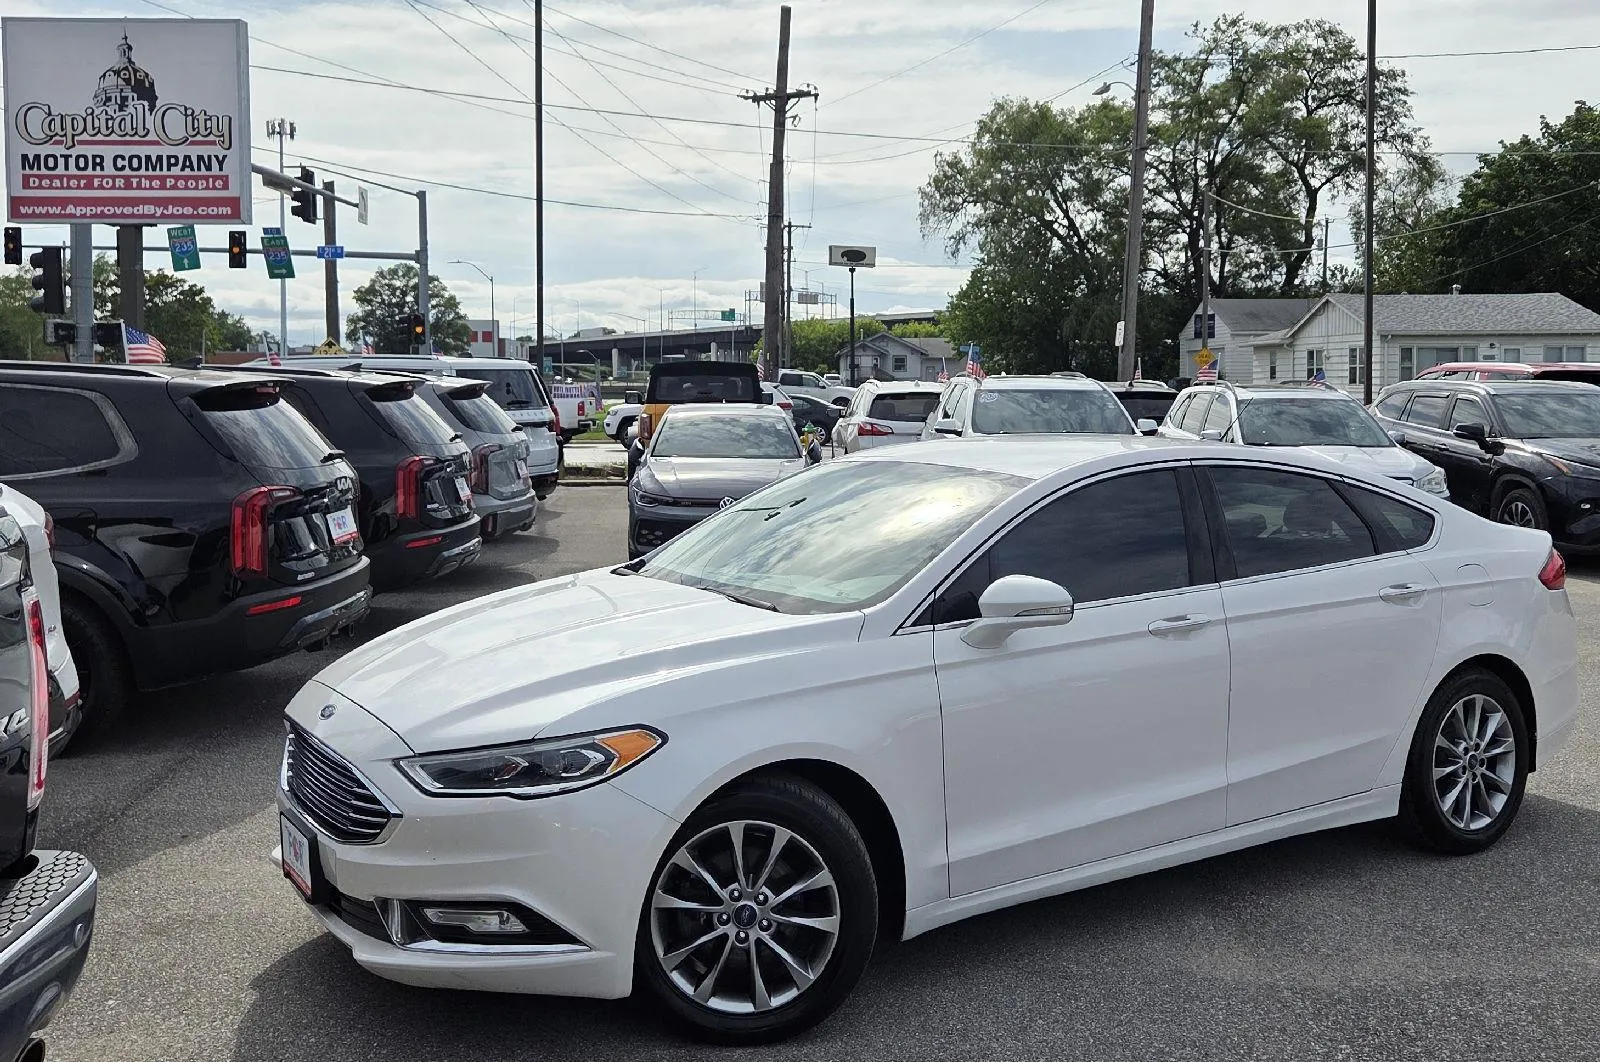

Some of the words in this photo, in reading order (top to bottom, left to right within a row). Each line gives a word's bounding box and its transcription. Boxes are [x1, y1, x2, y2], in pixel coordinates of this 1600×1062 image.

[15, 102, 150, 150] Capital
[153, 102, 232, 150] City
[20, 153, 105, 172] MOTOR
[112, 154, 228, 172] COMPANY
[29, 177, 87, 188] Dealer
[93, 178, 125, 188] FOR
[130, 178, 160, 189] The
[166, 177, 224, 190] People
[19, 204, 232, 217] www.ApprovedByJoe.com
[174, 241, 194, 252] 235
[269, 251, 287, 260] 235
